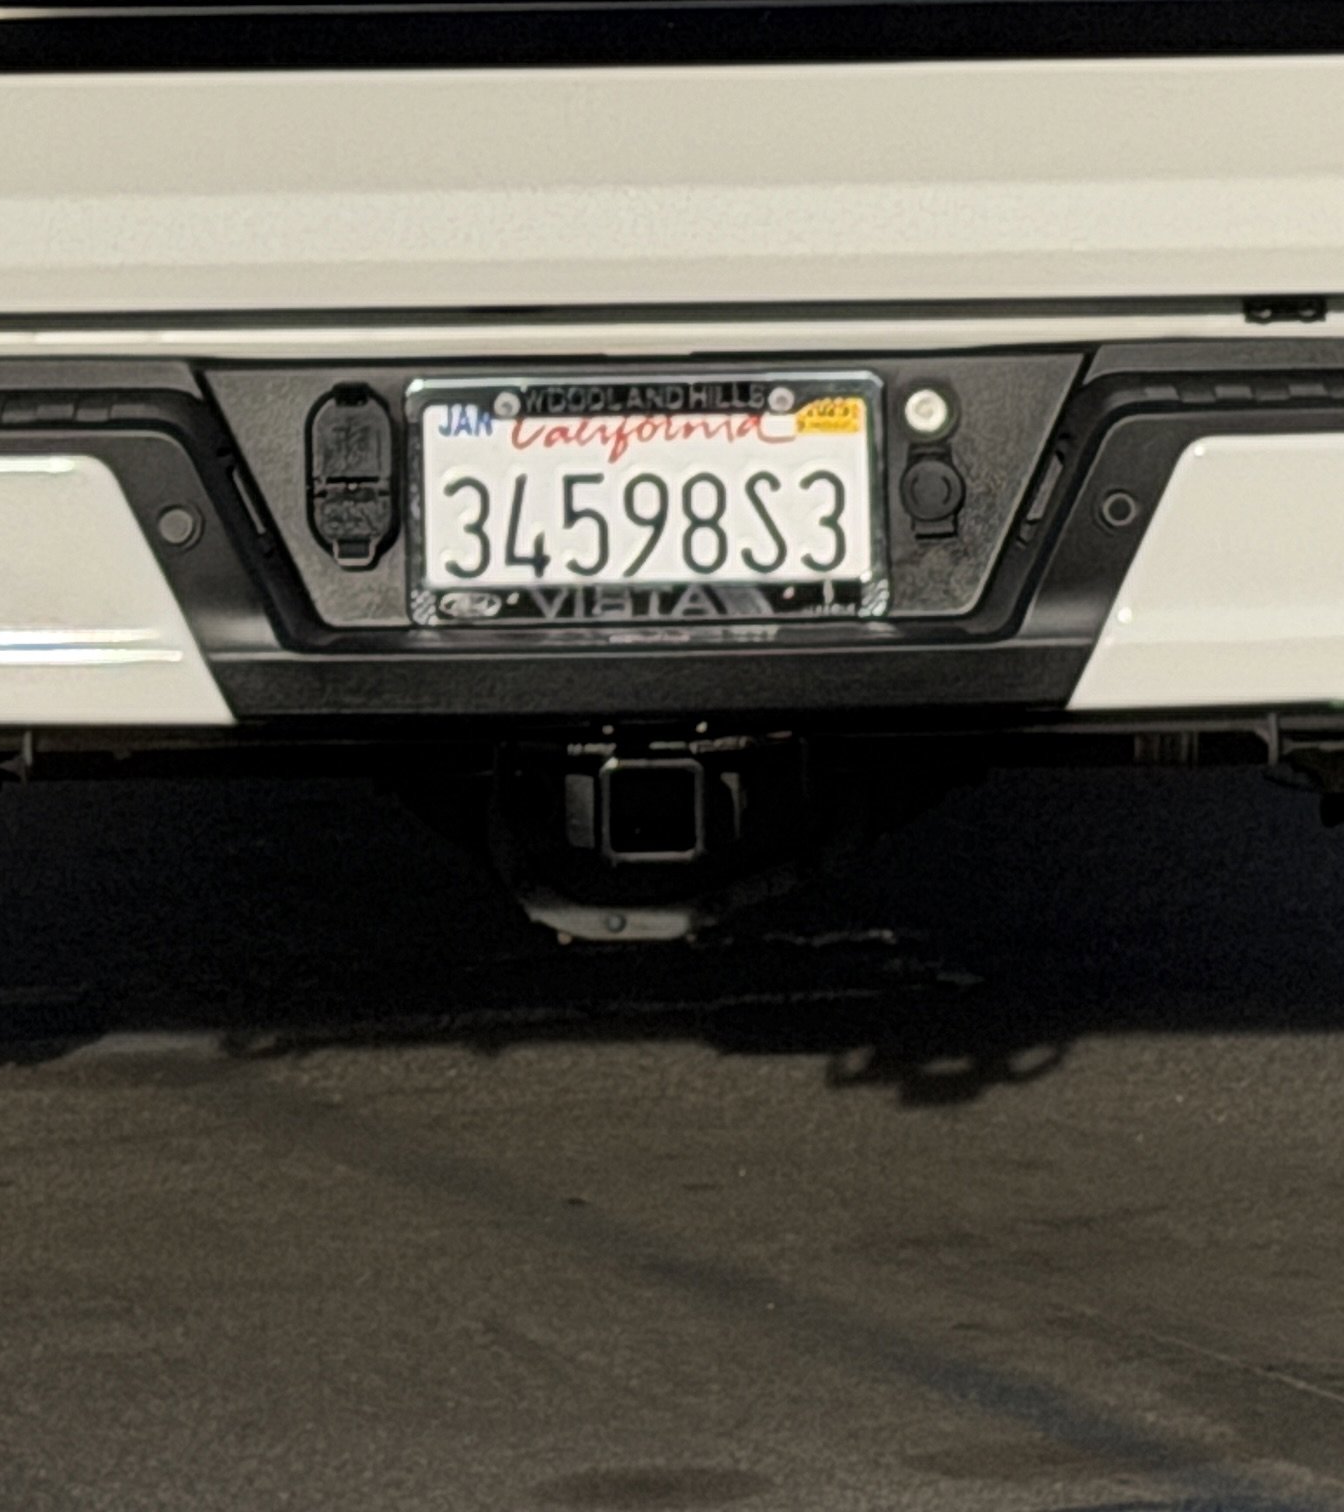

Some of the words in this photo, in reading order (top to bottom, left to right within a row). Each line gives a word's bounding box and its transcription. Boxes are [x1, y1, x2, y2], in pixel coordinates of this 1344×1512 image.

[524, 385, 685, 414] WOODLAND
[688, 382, 766, 410] HILLS
[438, 403, 494, 437] JAN
[511, 414, 796, 464] California
[442, 469, 847, 579] 34598S3
